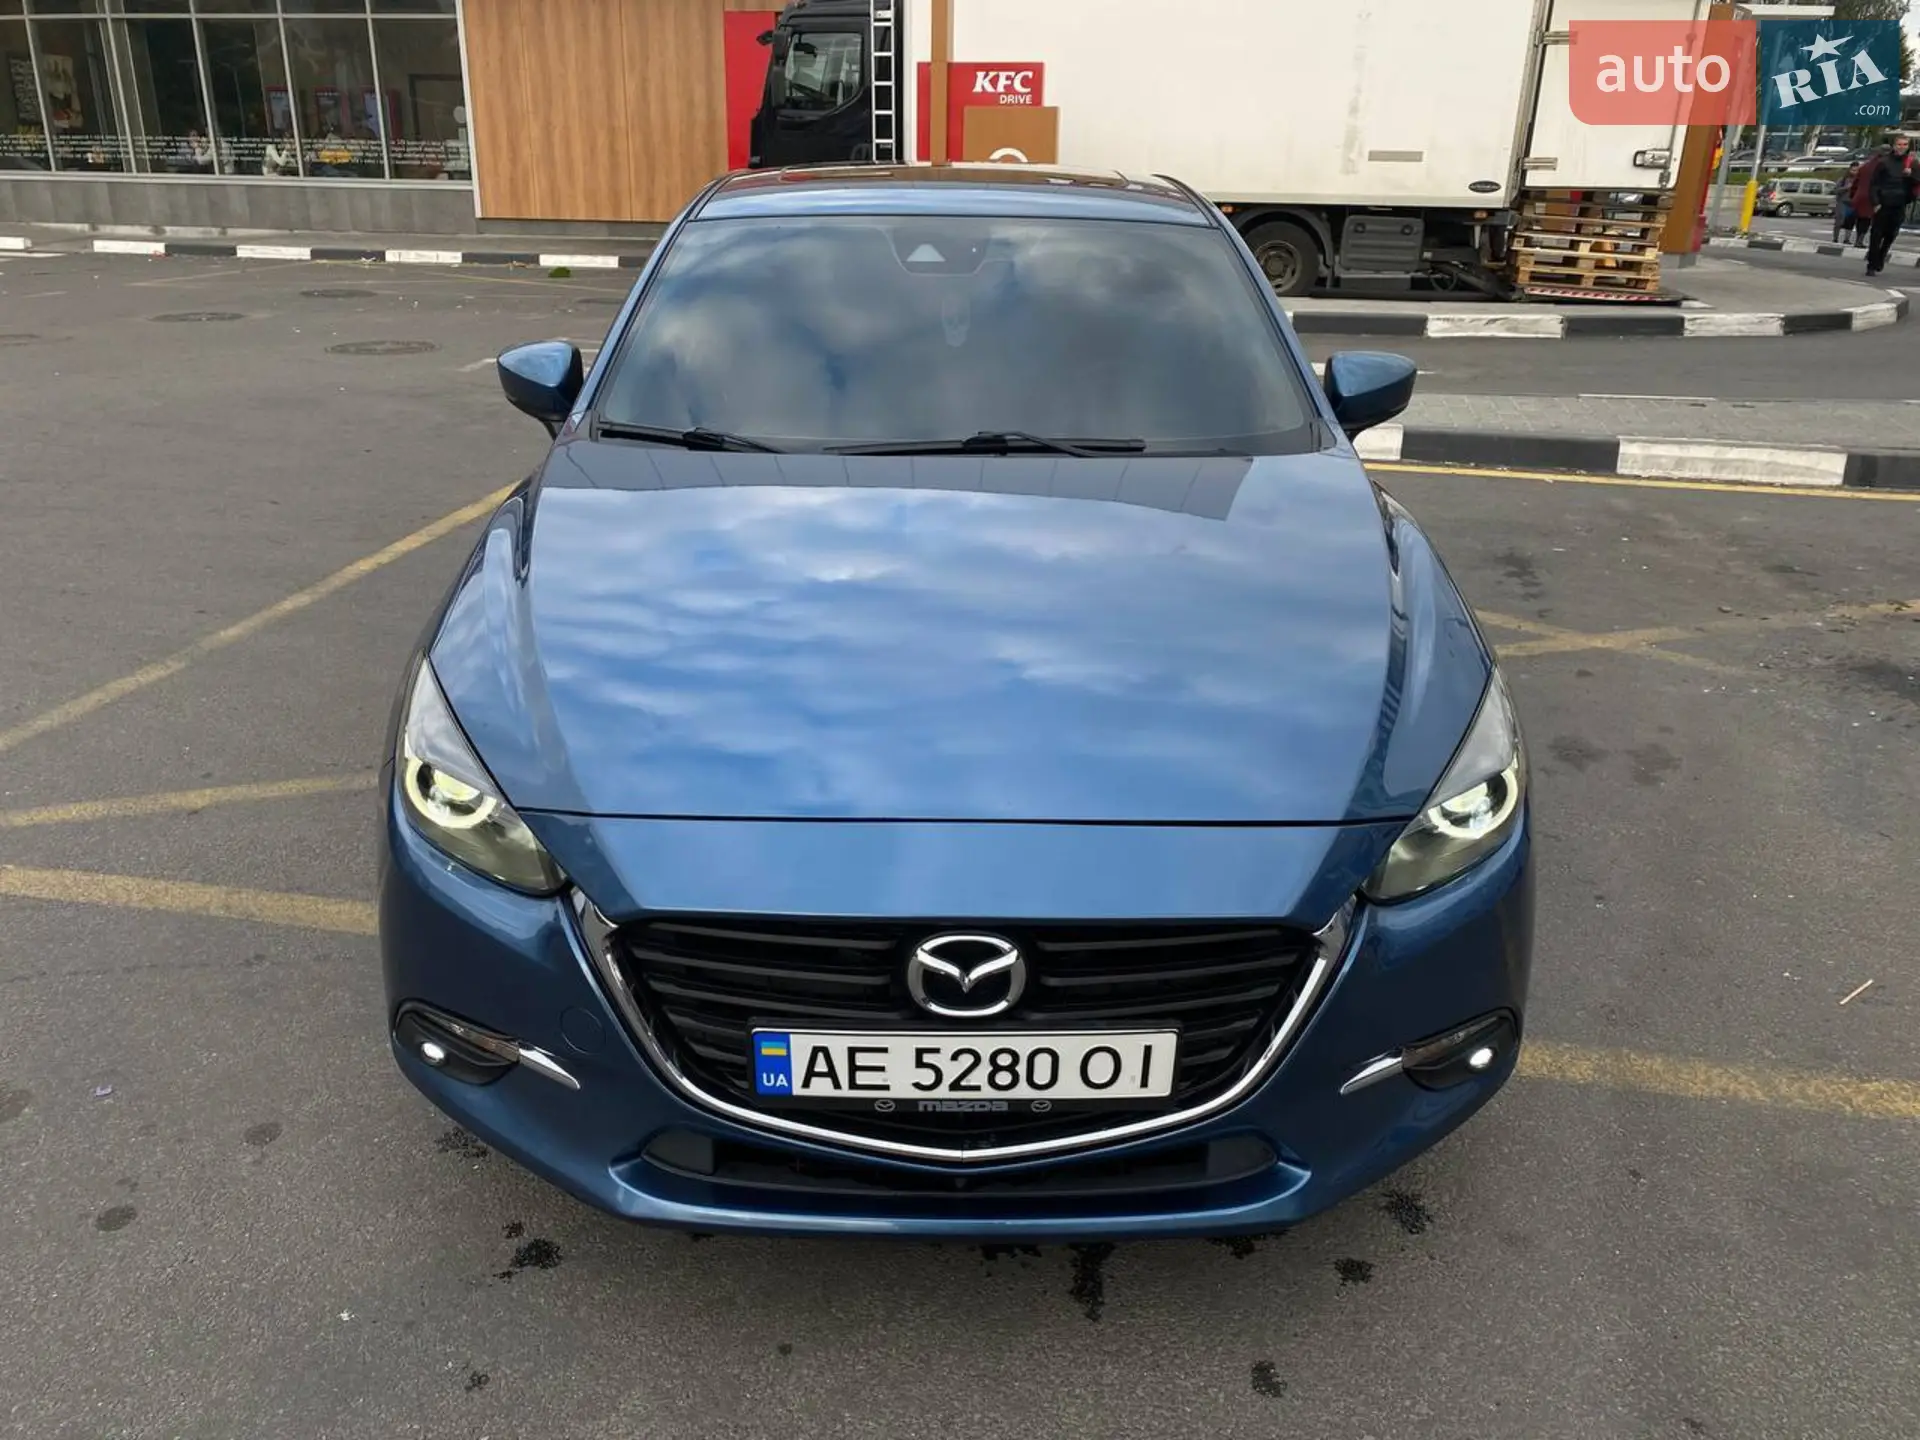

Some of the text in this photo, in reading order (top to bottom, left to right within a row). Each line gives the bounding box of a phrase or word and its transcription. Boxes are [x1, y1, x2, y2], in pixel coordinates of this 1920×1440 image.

[972, 71, 1033, 93] KFC
[999, 94, 1033, 105] DRIVE
[801, 1045, 891, 1091] AE
[911, 1046, 1060, 1092] 5280
[762, 1072, 788, 1088] UA
[917, 1100, 1009, 1113] mazda
